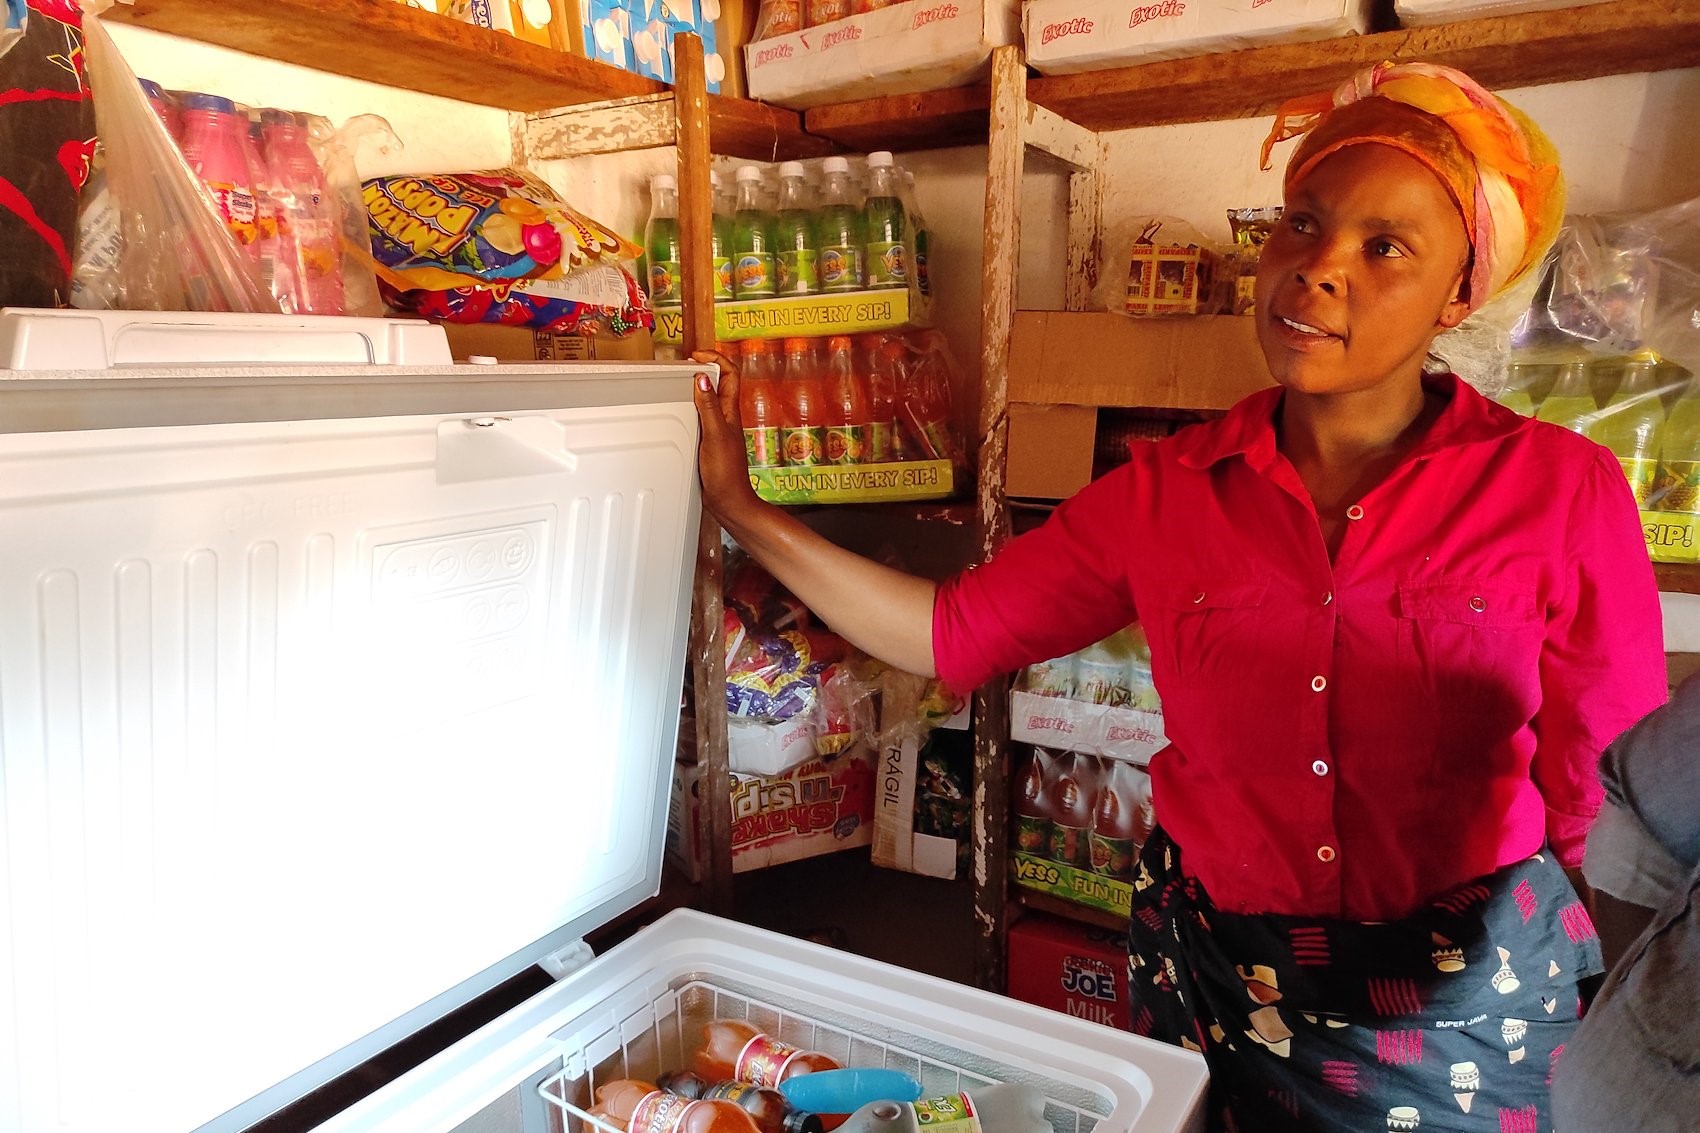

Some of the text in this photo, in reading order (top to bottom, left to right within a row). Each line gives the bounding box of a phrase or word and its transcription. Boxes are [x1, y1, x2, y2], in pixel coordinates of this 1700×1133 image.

[912, 2, 958, 30] Exotic
[1129, 1, 1186, 28] Exotic
[821, 25, 862, 51] Exotic
[1042, 17, 1094, 45] Exotic
[755, 43, 794, 68] Exotic
[727, 302, 891, 329] FUN IN EVERY SIP!
[775, 473, 813, 491] FUN
[816, 472, 838, 489] IN
[840, 469, 900, 489] EVERY
[902, 467, 938, 486] SIP!
[1643, 523, 1694, 547] SIP!
[1027, 715, 1075, 734] Exotic
[1106, 726, 1157, 744] Exotic
[884, 747, 904, 807] RÁGIL
[1014, 857, 1133, 908] YESS FUN IN
[1062, 966, 1116, 1000] JOE
[1066, 997, 1115, 1027] Milk
[1435, 1013, 1488, 1028] SUPER JAVA
